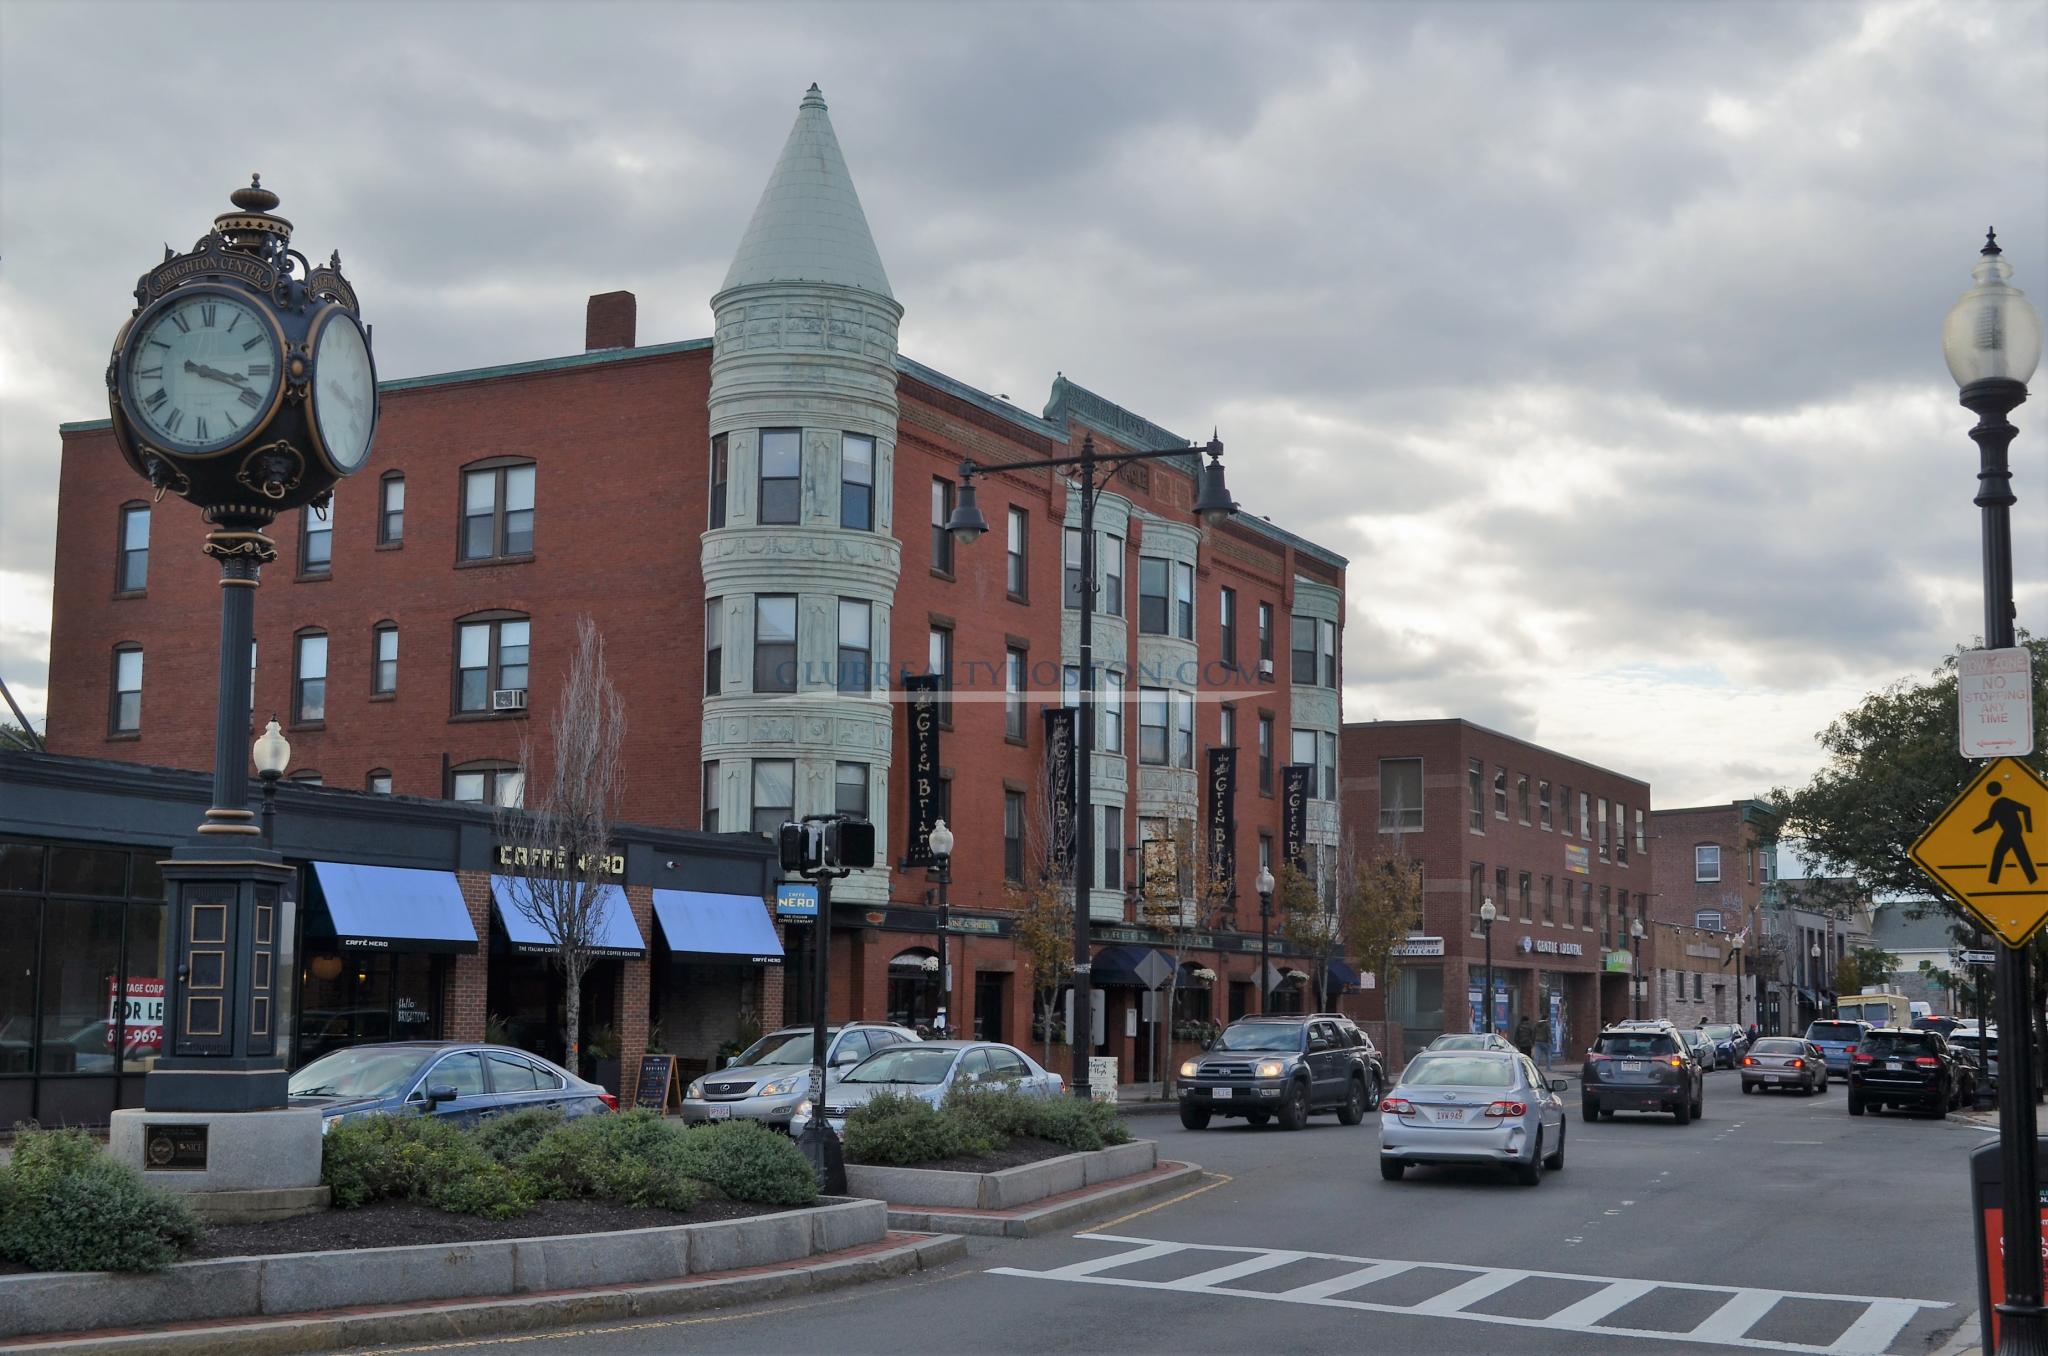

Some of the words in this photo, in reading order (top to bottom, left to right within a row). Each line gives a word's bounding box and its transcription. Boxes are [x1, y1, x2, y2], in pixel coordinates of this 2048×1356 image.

[159, 255, 217, 285] BRIGHTON
[220, 257, 264, 283] CENTER
[1983, 676, 2006, 689] NO
[1964, 690, 2025, 703] STOPPING
[1983, 703, 2005, 713] ANY
[1979, 713, 2009, 724] TIME
[778, 898, 815, 908] NERO
[1101, 929, 1149, 941] GREEN
[1536, 940, 1558, 953] GENTLE
[1562, 942, 1583, 956] DENTAL
[145, 983, 164, 993] CORP
